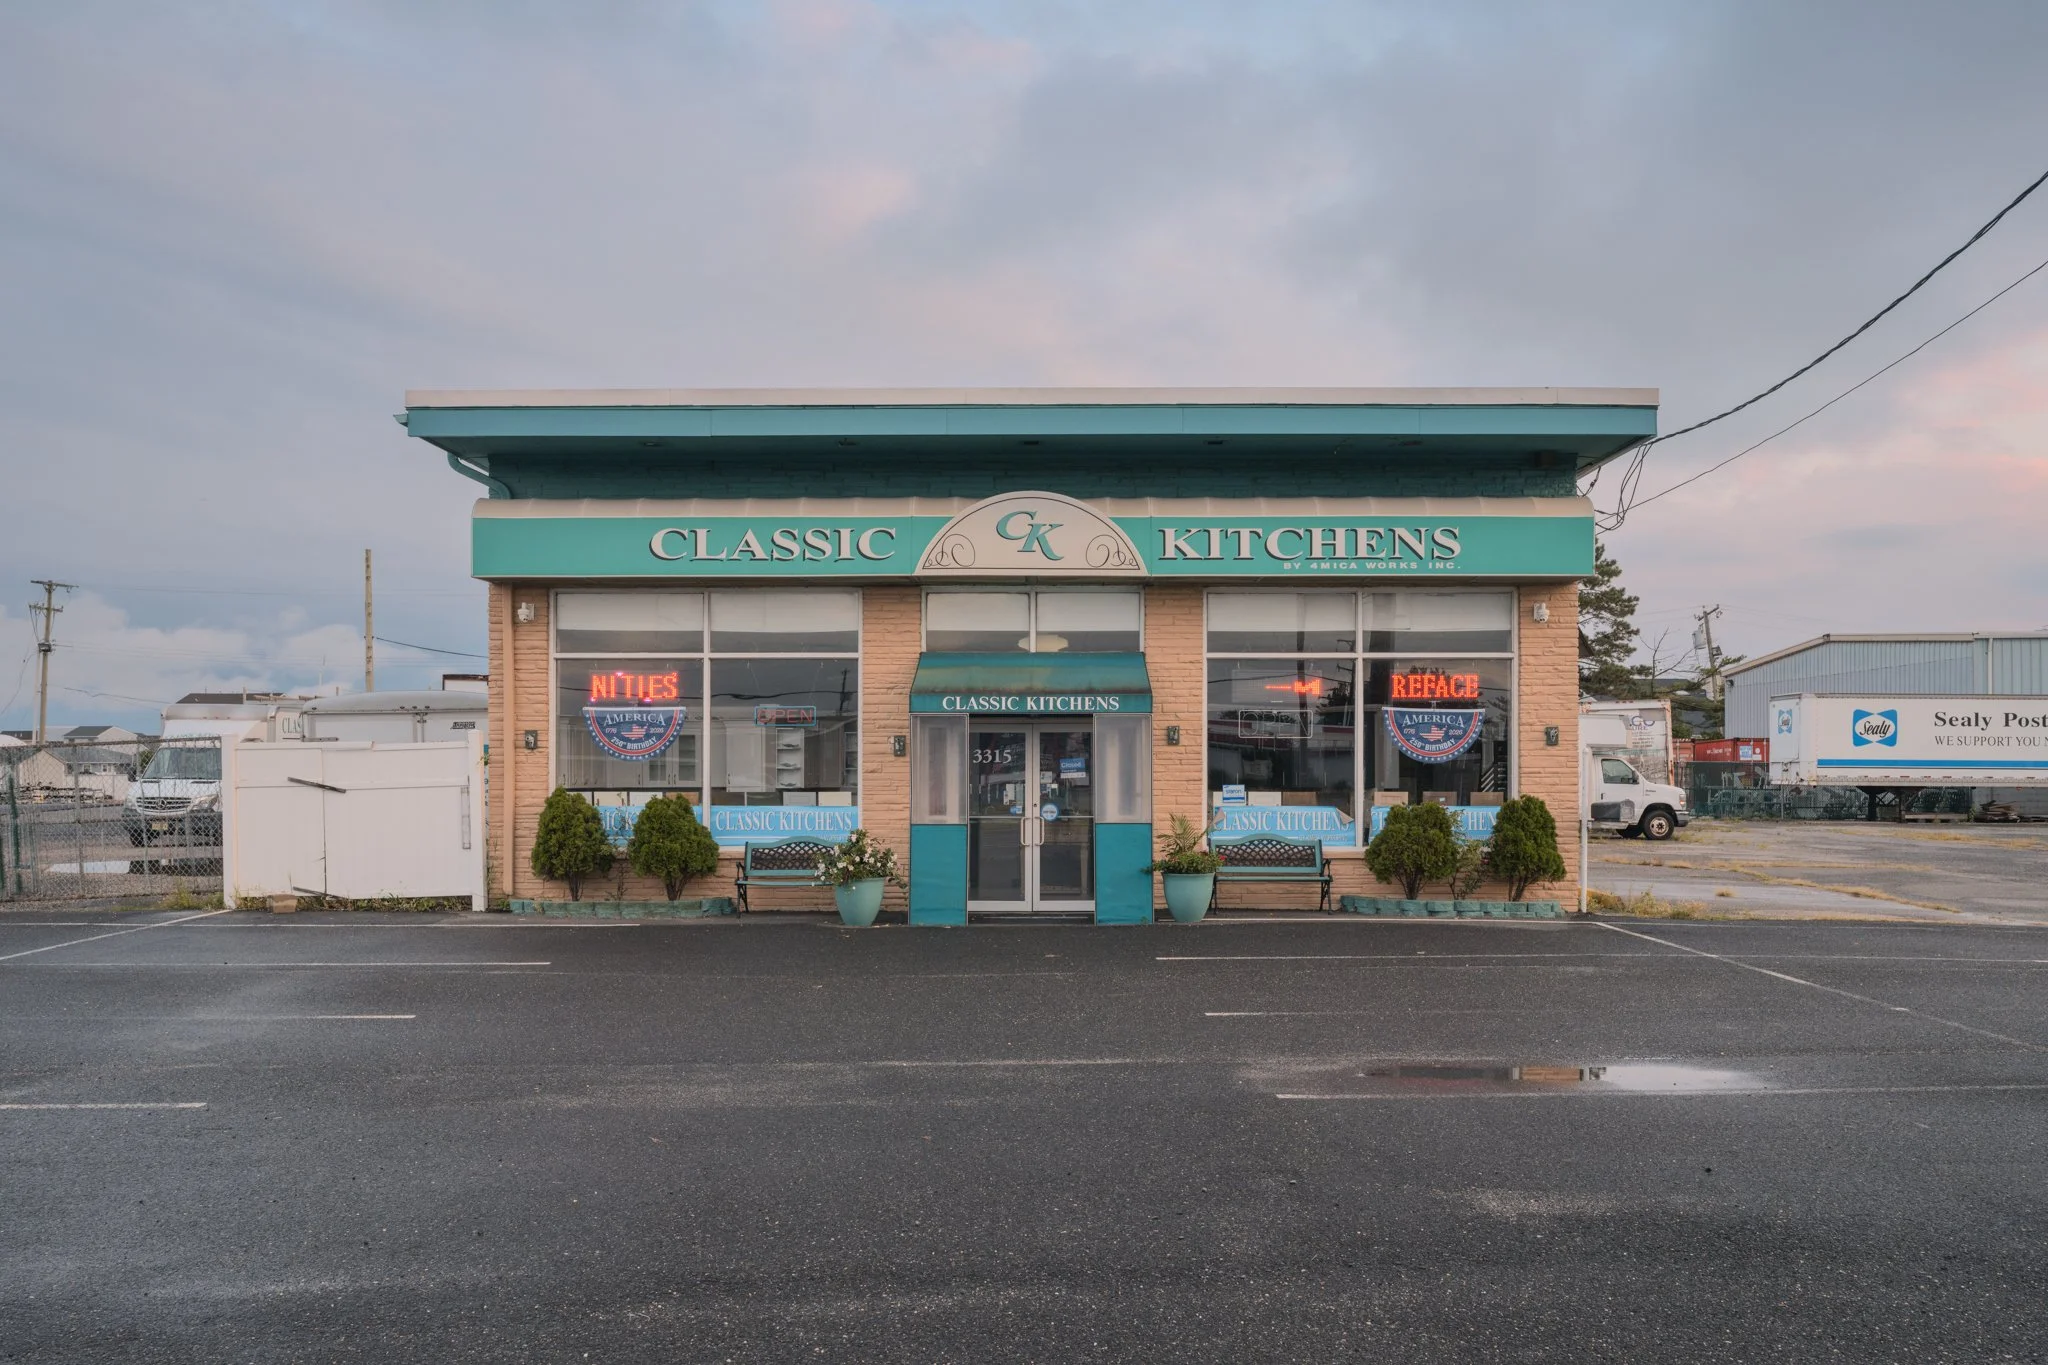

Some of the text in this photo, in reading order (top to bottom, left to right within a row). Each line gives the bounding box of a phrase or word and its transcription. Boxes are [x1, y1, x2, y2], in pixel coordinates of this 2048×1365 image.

[996, 510, 1064, 561] CK
[648, 526, 1461, 562] CLASSIC KITCHENS
[1283, 562, 1461, 570] BY 4MICA WORKS INC.
[1391, 674, 1479, 698] REFACE
[942, 696, 1120, 710] CLASSIC KITCHENS
[603, 713, 666, 727] AMERICA
[757, 709, 813, 724] OPEN
[1402, 714, 1465, 728] AMERICA
[1934, 711, 1992, 731] Sealy
[1860, 720, 1891, 738] Sealy
[626, 736, 658, 750] BIRTHDAY
[1424, 738, 1456, 751] BIRTHDAY
[1935, 735, 1955, 746] WE
[1957, 735, 2012, 747] SUPPORT
[2015, 736, 2040, 747] YOU
[972, 749, 1012, 764] 3315
[715, 811, 852, 831] CLASSIC KITCHENS
[1214, 811, 1273, 831] LASSIC
